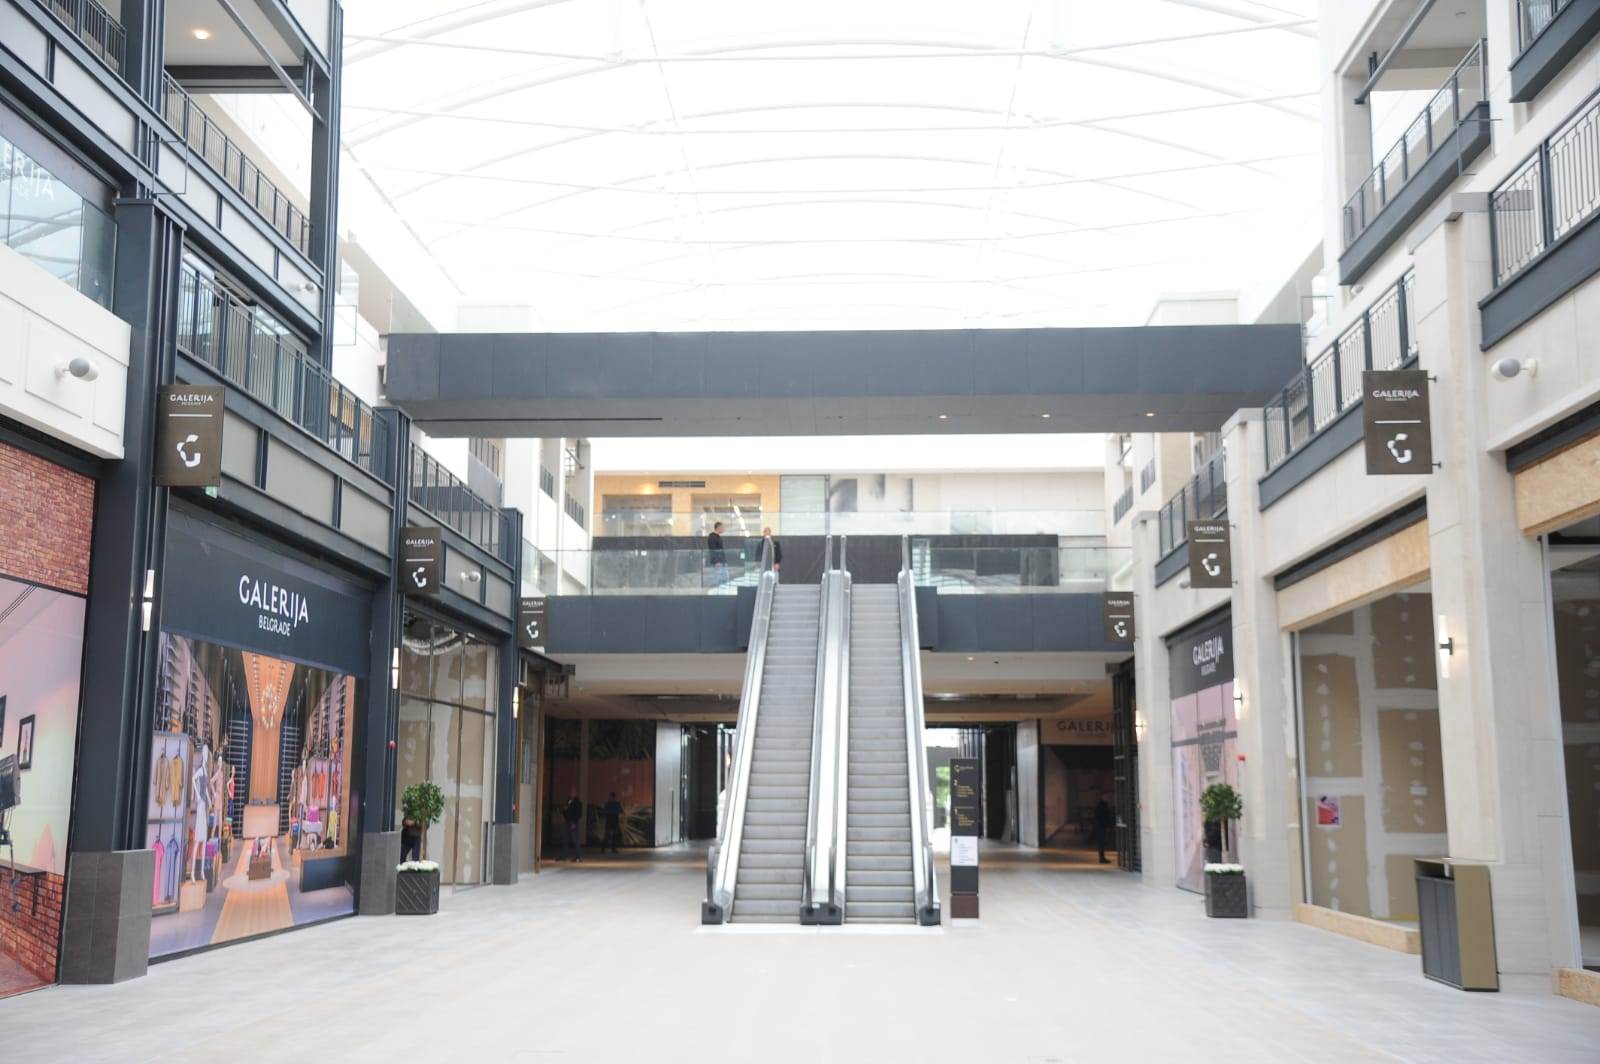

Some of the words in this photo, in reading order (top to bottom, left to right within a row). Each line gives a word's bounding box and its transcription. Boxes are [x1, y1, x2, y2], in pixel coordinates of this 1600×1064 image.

[169, 394, 214, 404] GALERIJA
[1372, 389, 1420, 399] GALERIJA
[239, 574, 309, 628] GALERIJA
[258, 614, 291, 637] BELGRADE
[1192, 636, 1224, 665] GALERIJA
